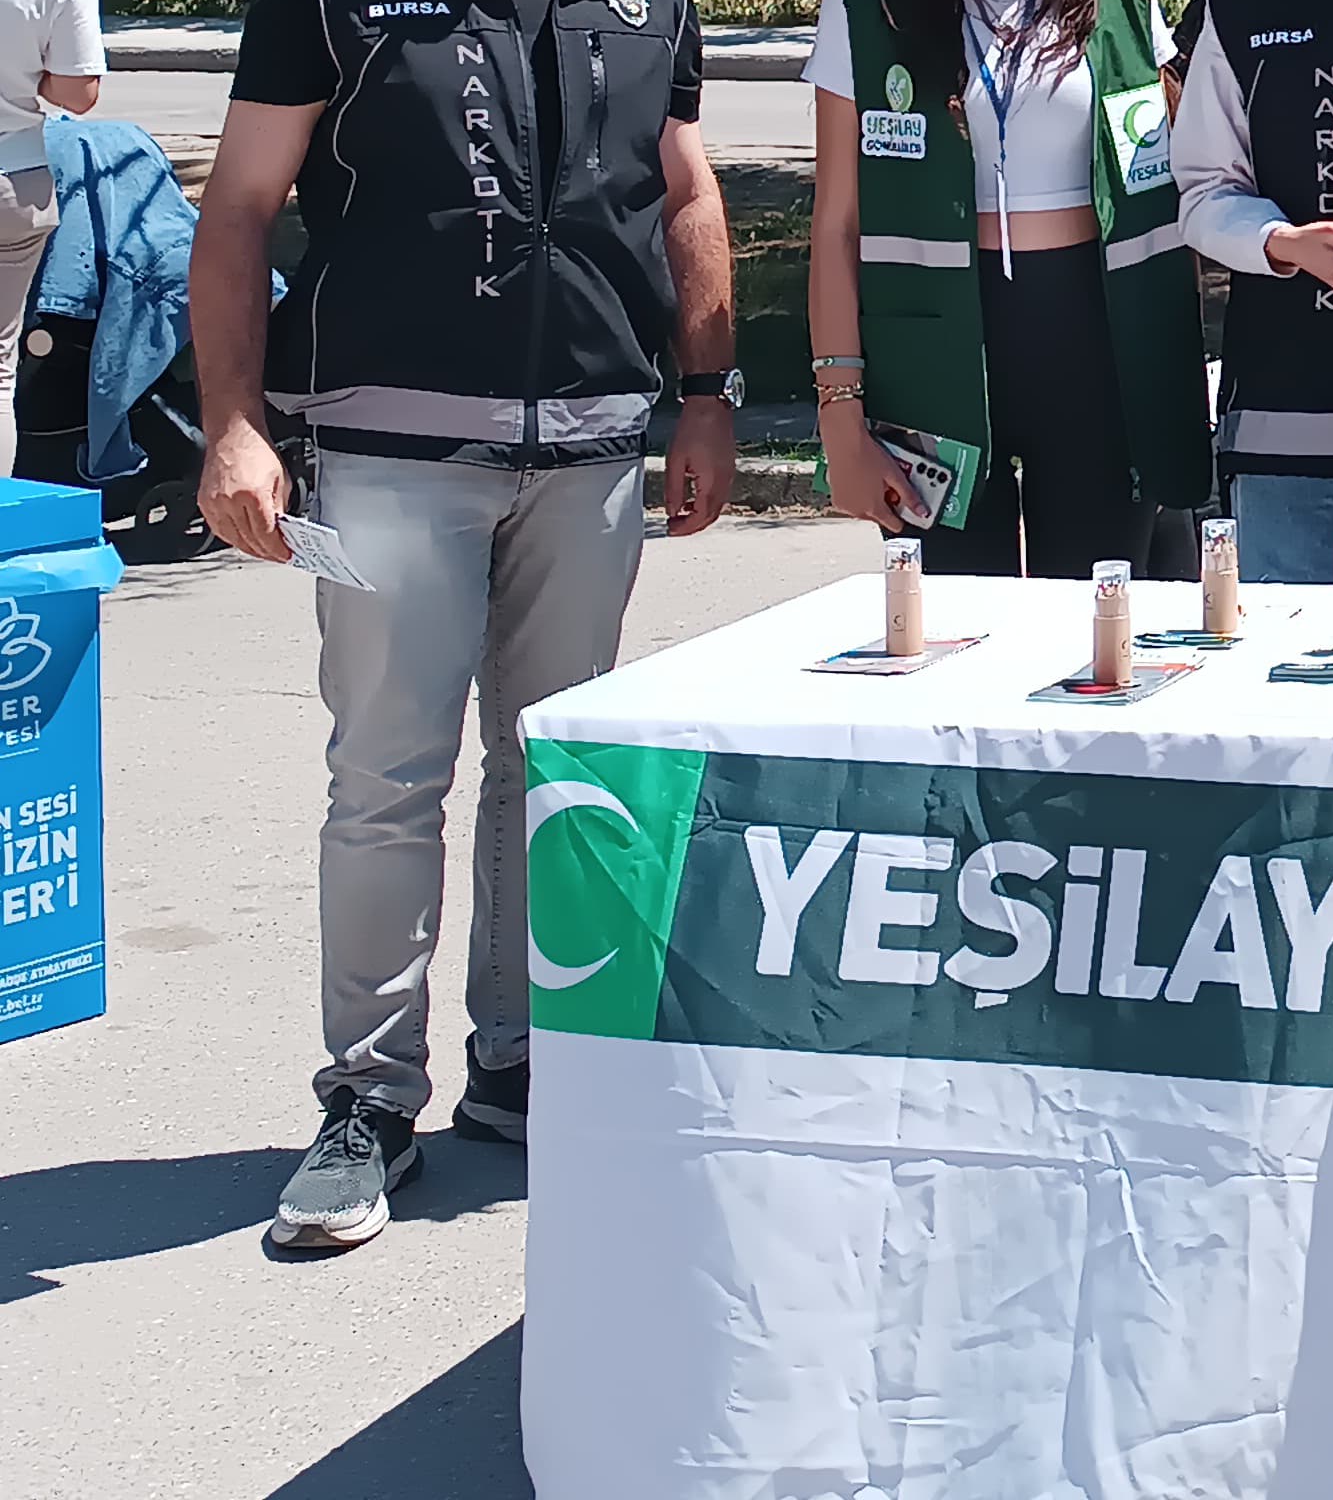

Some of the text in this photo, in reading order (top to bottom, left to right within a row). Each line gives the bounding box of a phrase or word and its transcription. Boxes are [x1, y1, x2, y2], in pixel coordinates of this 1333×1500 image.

[368, 1, 451, 19] BURSA
[1250, 28, 1315, 49] BURSA
[457, 43, 502, 299] NARKOTİK
[18, 784, 78, 827] SESİ
